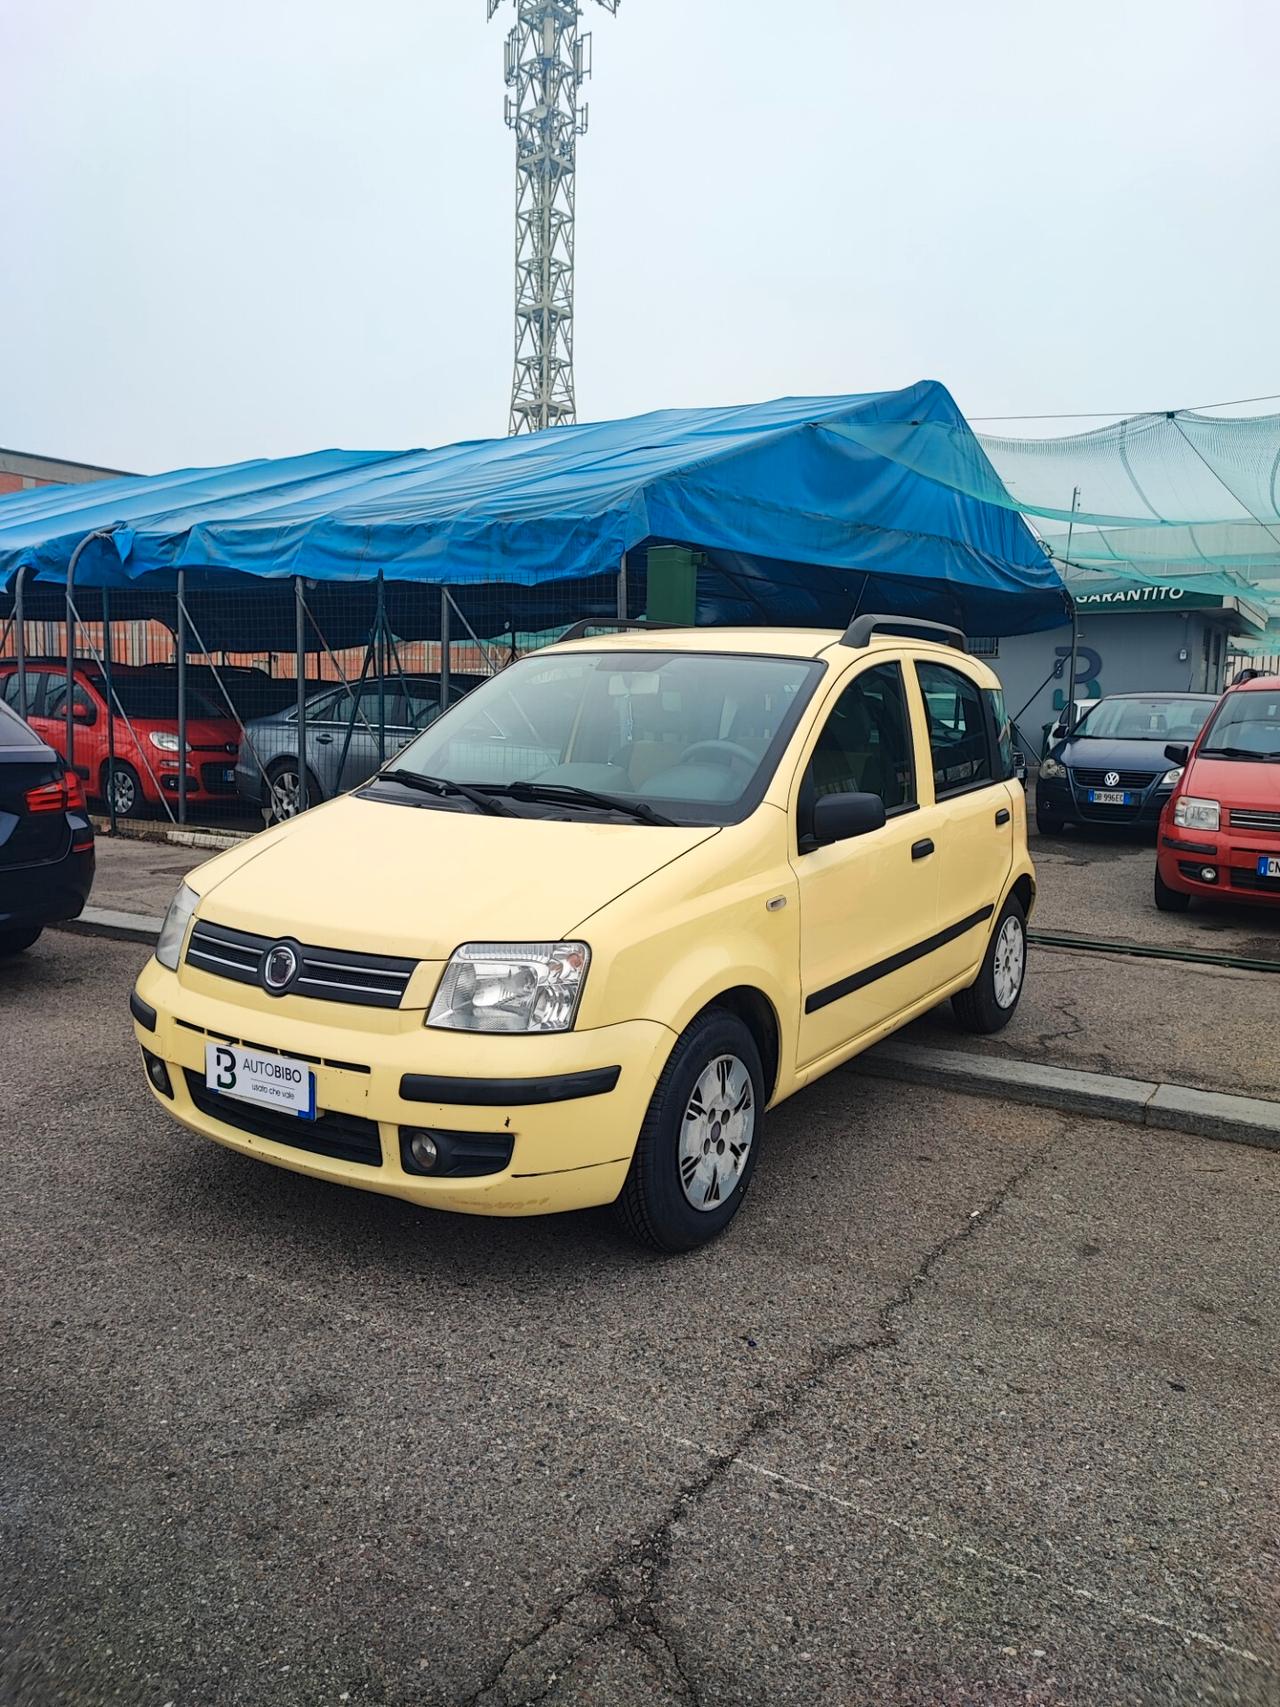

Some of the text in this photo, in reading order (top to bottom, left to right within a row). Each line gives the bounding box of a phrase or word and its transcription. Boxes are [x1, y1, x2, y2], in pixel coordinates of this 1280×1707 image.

[242, 1058, 302, 1083] AUTOBIBO
[252, 1084, 295, 1100] usato che vale
